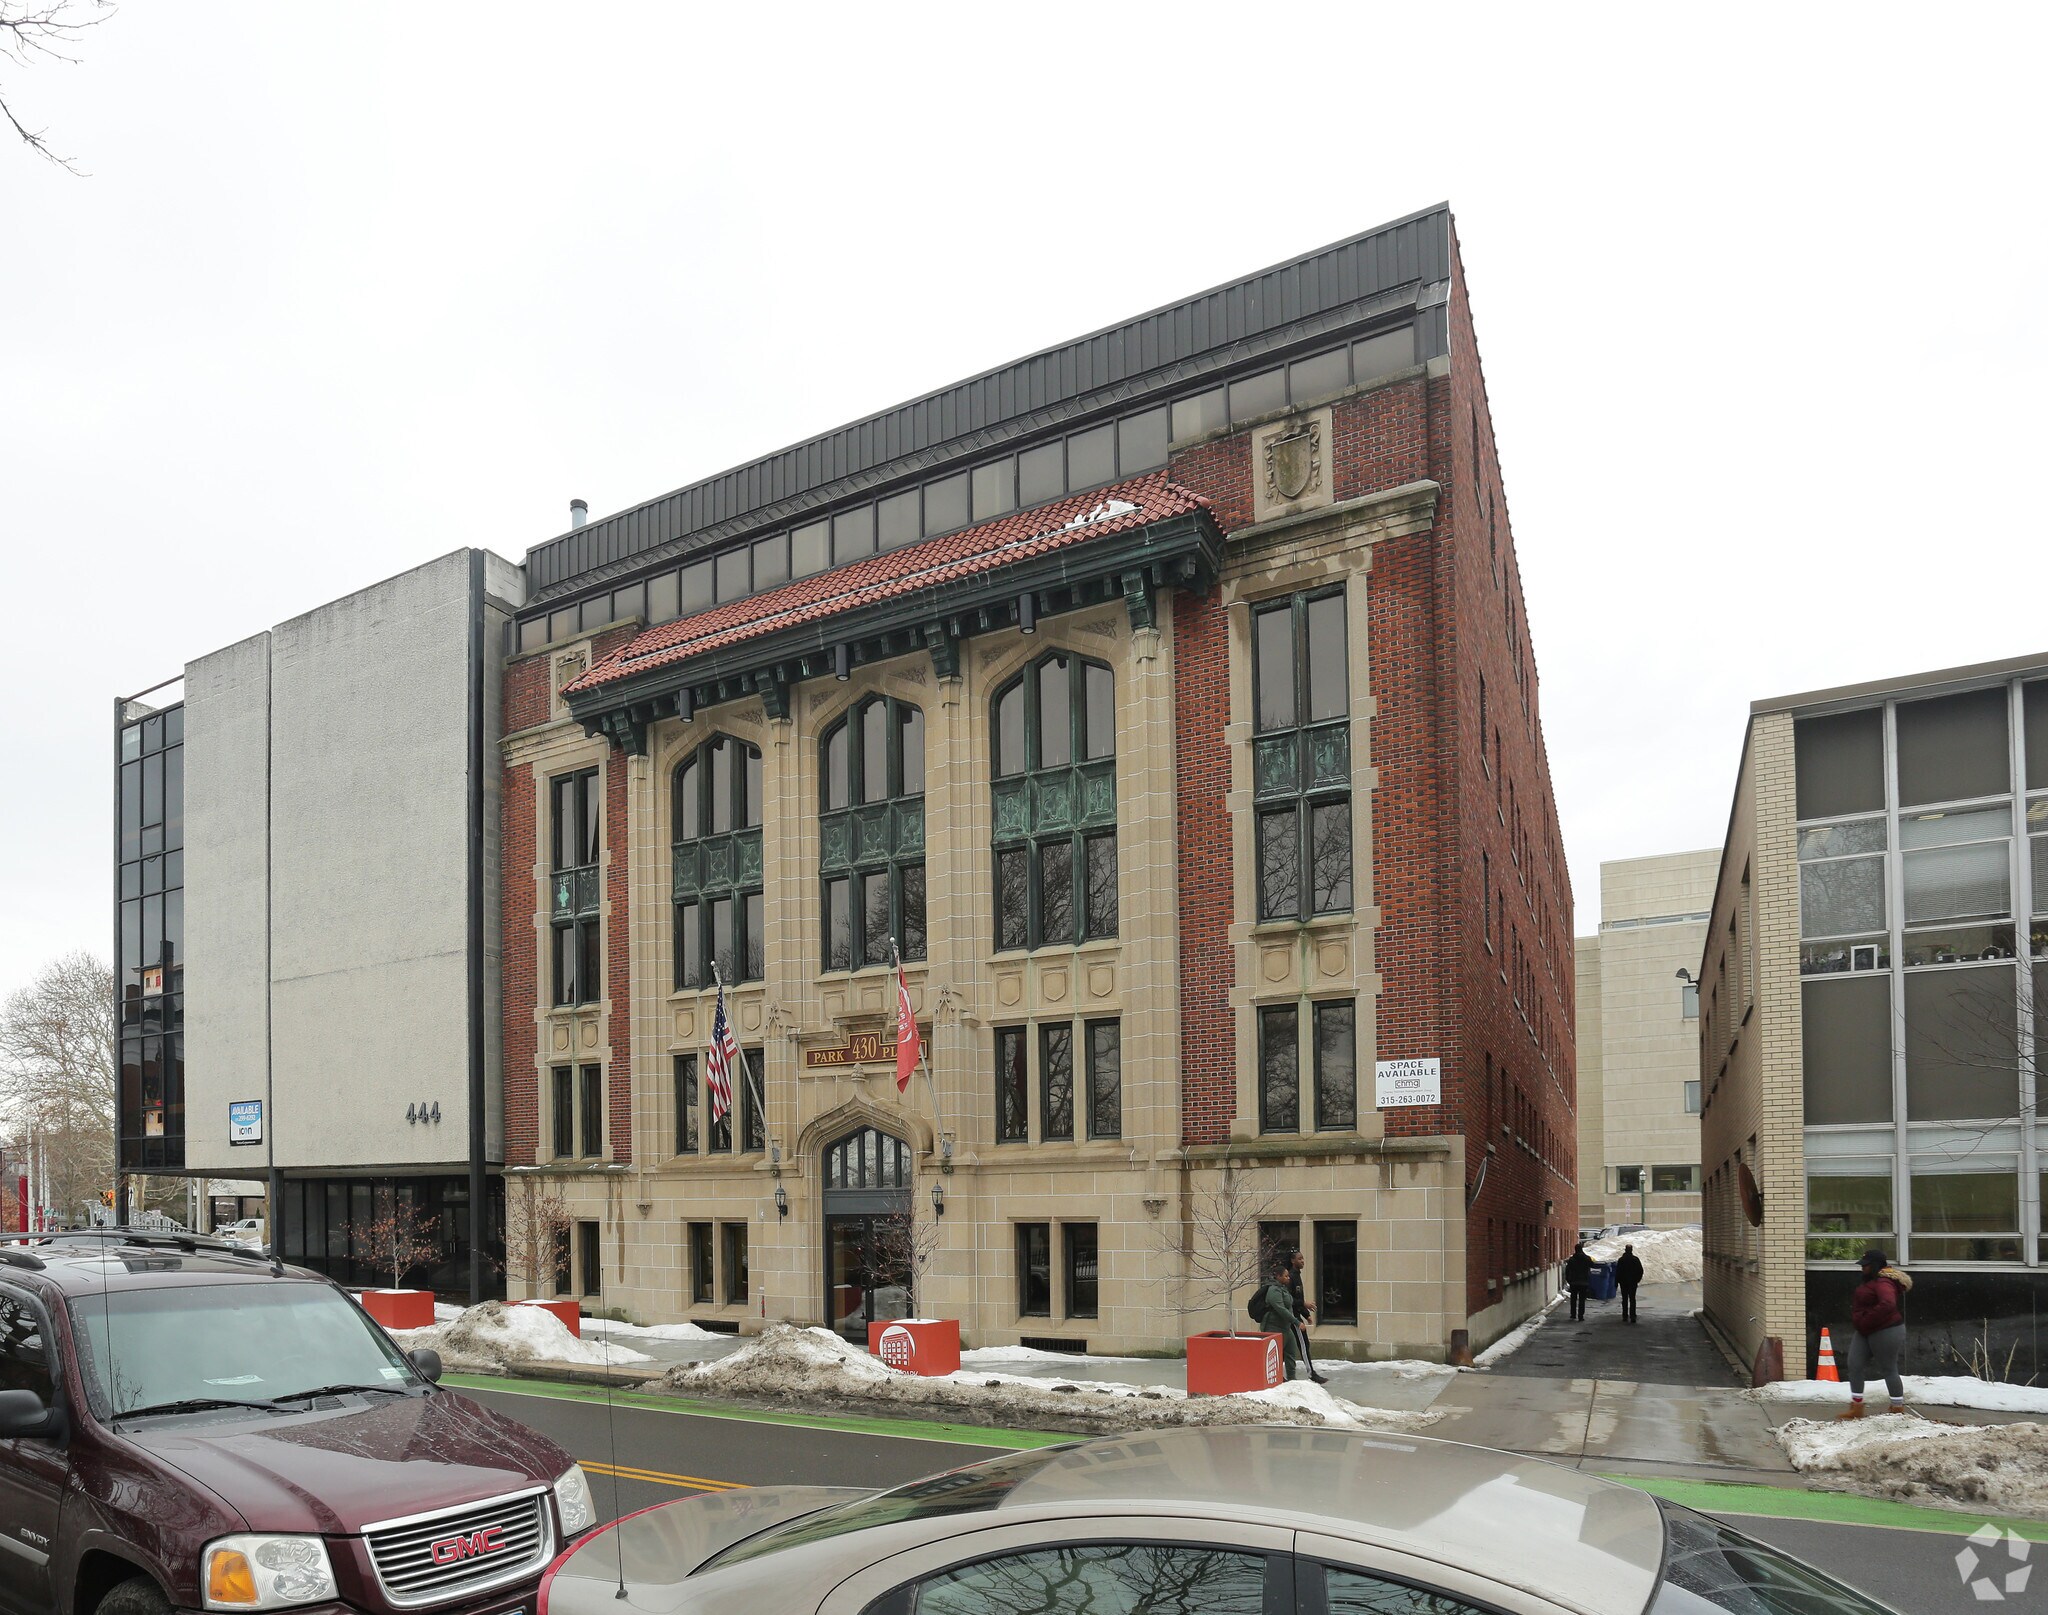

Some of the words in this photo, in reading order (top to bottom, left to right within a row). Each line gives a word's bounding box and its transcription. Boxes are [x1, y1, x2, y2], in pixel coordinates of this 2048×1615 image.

[814, 1051, 845, 1063] PARK
[852, 1036, 877, 1060] 430
[1390, 1060, 1424, 1070] SPACE
[1378, 1068, 1437, 1078] AVAILABLE
[1381, 1094, 1436, 1105] 315-263-0072
[231, 1104, 259, 1116] AVAILABLE
[405, 1100, 441, 1125] 444
[20, 1527, 50, 1546] ENVOY
[431, 1526, 506, 1565] GMC
